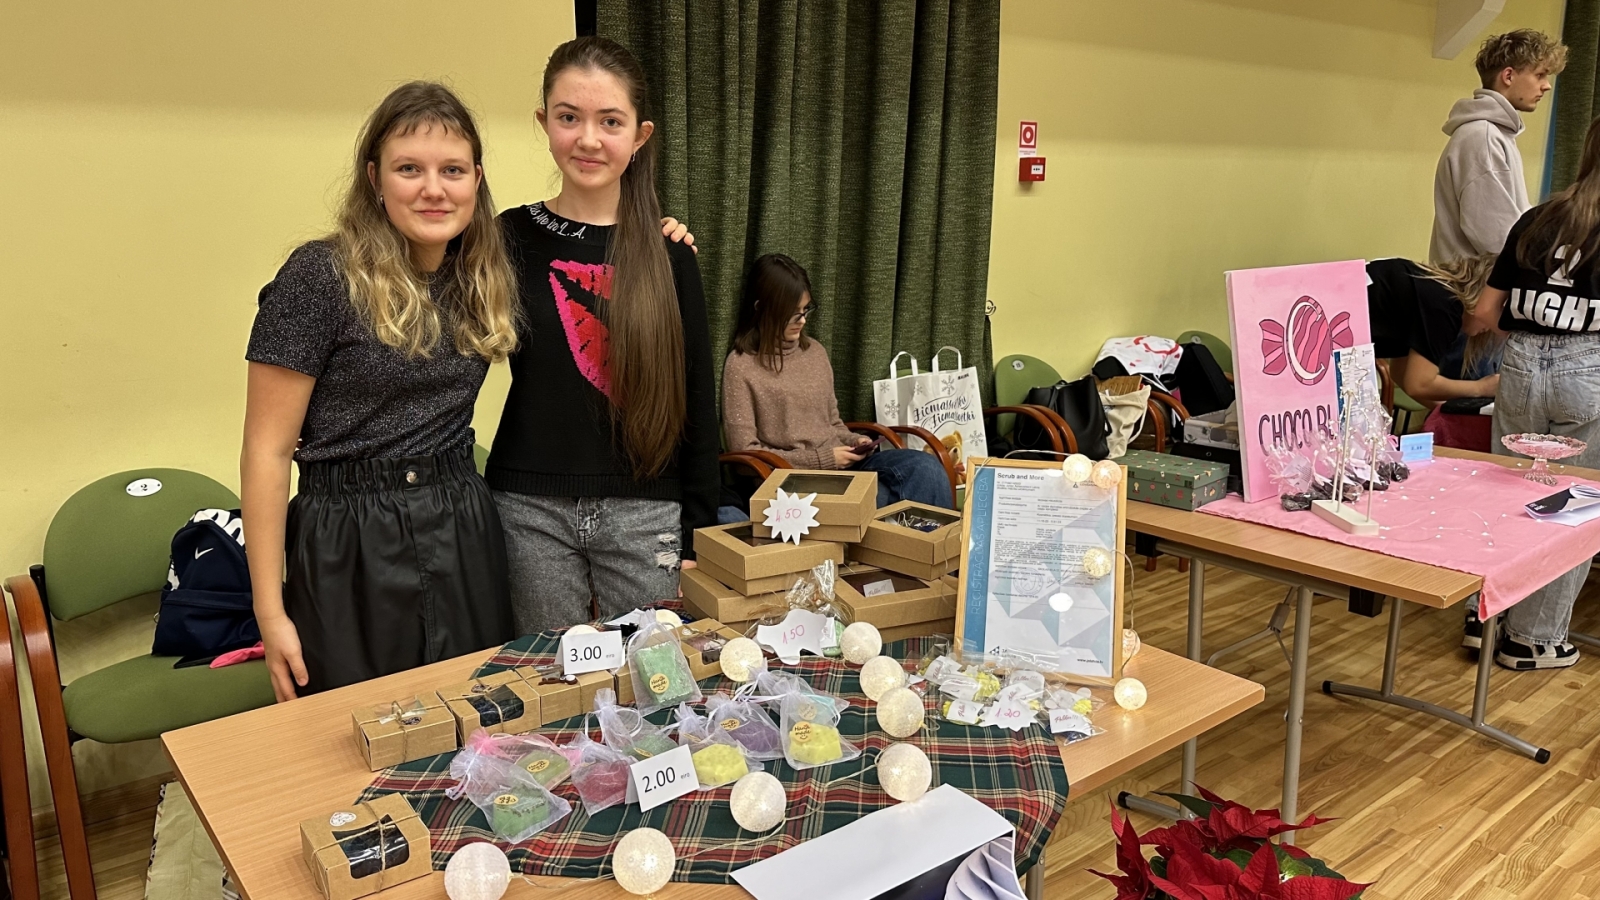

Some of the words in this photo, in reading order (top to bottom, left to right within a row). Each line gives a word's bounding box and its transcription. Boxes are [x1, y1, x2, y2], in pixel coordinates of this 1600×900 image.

[1258, 408, 1313, 457] CHOCO
[570, 645, 602, 662] 3.00
[641, 766, 676, 793] 2.00
